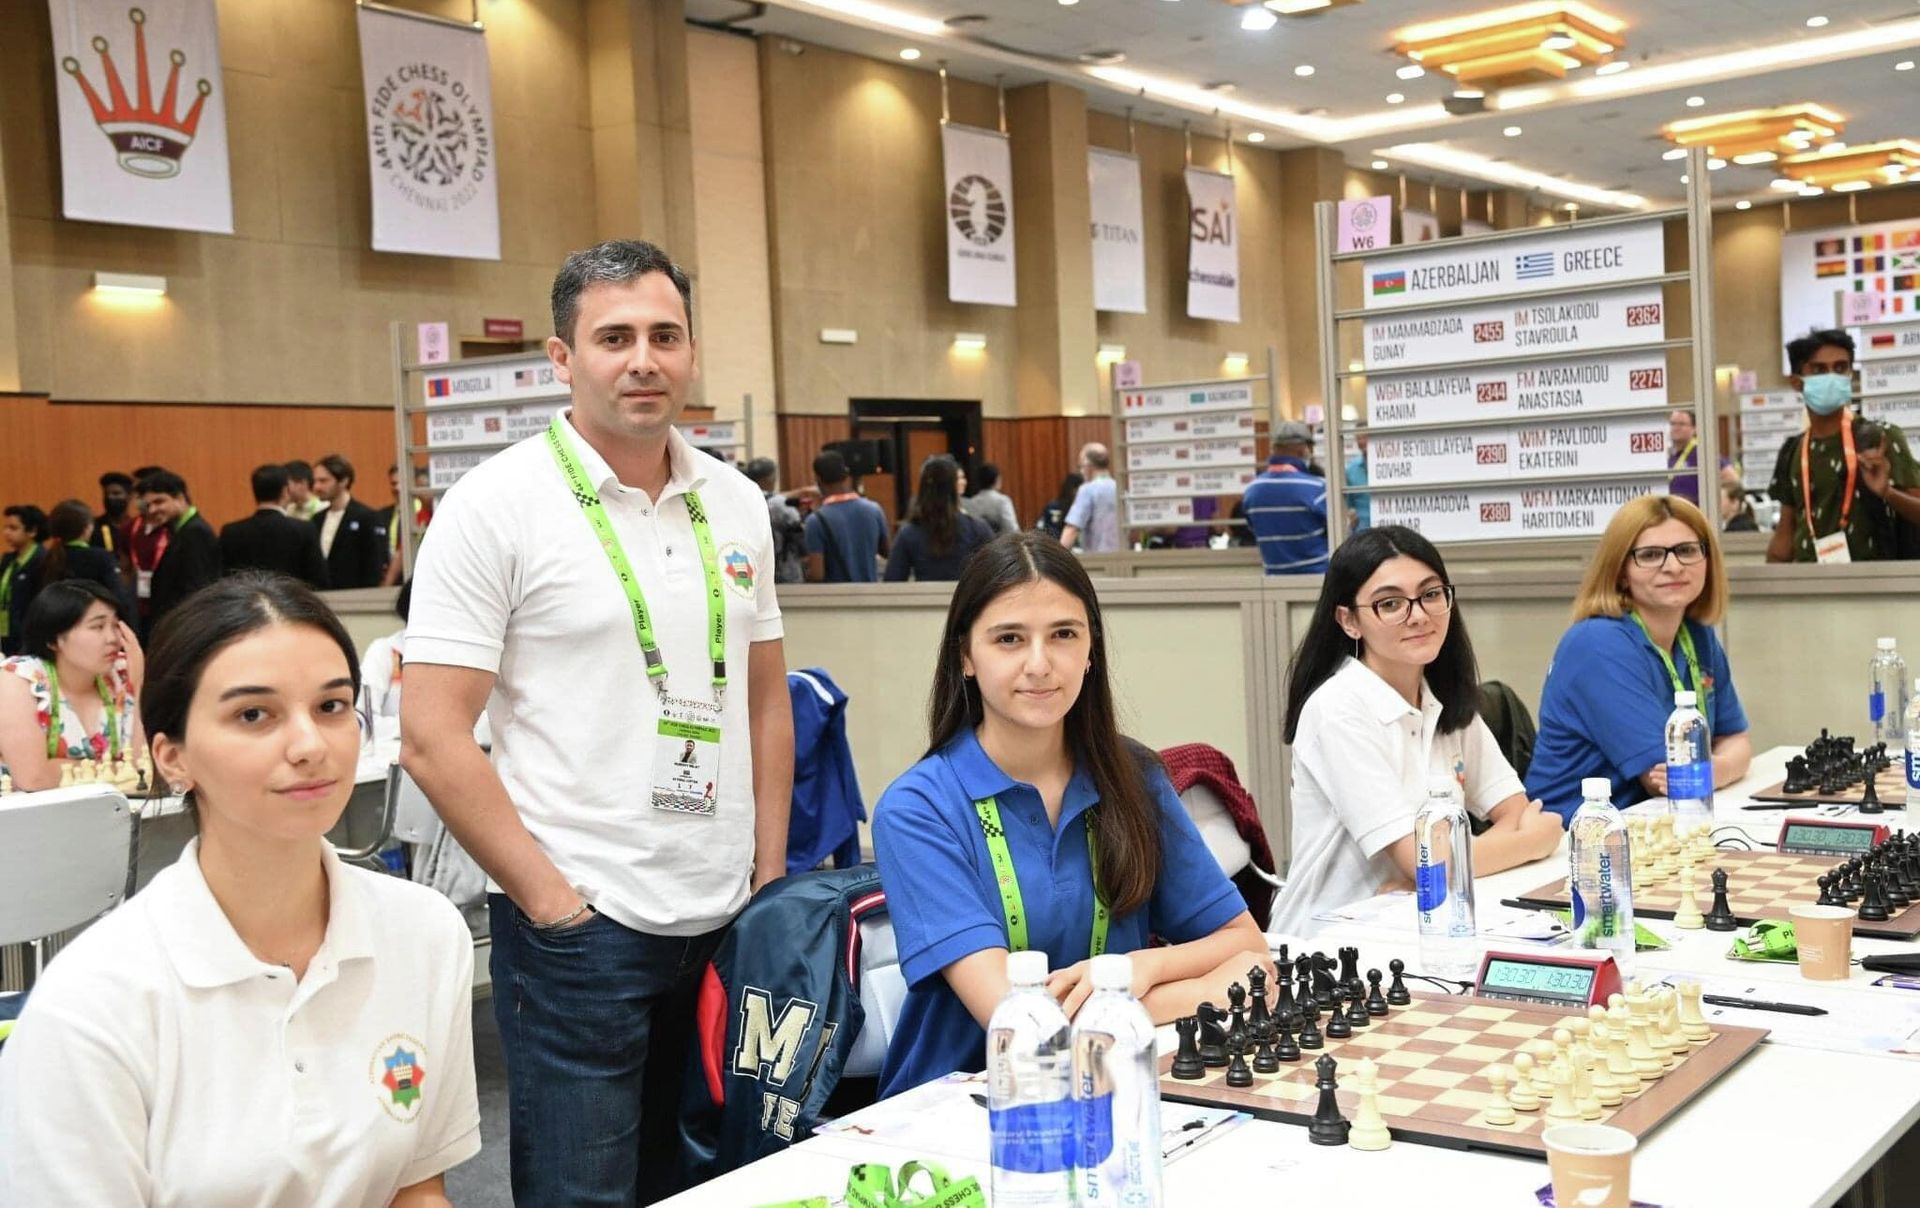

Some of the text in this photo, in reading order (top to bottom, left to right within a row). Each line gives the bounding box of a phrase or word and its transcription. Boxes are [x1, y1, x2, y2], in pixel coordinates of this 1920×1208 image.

[372, 77, 399, 118] FIDE
[397, 63, 449, 85] CHESS
[452, 81, 488, 182] OLYMPIAD
[130, 135, 164, 152] AICF
[1102, 223, 1138, 244] TITAN
[1352, 236, 1374, 249] W6
[1563, 245, 1624, 273] GREECE
[1411, 259, 1500, 291] AZERBAIJAN
[1514, 301, 1600, 327] IM TSOLAKIDOU
[1628, 304, 1660, 325] 2362
[1372, 318, 1464, 341] IM MAMMADZADA
[1474, 322, 1504, 342] 2455
[1515, 326, 1579, 346] STAVROULA
[1373, 344, 1405, 361] GUNAY
[452, 377, 491, 394] MONGOLIA
[537, 369, 554, 385] USA
[1517, 365, 1609, 388] FM AVRAMIDOU
[1630, 369, 1663, 389] 2274
[1375, 377, 1472, 401] WGM BALAJAYEVA
[1477, 383, 1507, 402] 2344
[1517, 390, 1584, 410] ANASTASIA
[1375, 403, 1416, 422] KHANIM
[1518, 425, 1607, 448] WIM PAVLIDOU
[1630, 432, 1664, 452] 2138
[1375, 436, 1474, 459] WGM BEYDULLAYEVA
[1477, 445, 1507, 464] 2390
[1519, 450, 1578, 471] EKATERINI
[564, 463, 578, 480] FIDE
[1375, 464, 1413, 480] GOVHAR
[1378, 494, 1470, 514] IM MAMMADOVA
[1521, 490, 1553, 508] WFM
[1480, 502, 1510, 522] 2380
[1522, 510, 1594, 529] HARITOMENI
[633, 599, 646, 630] Player
[715, 613, 723, 644] Player
[1419, 843, 1432, 924] smartwater
[1599, 852, 1613, 937] smartwater
